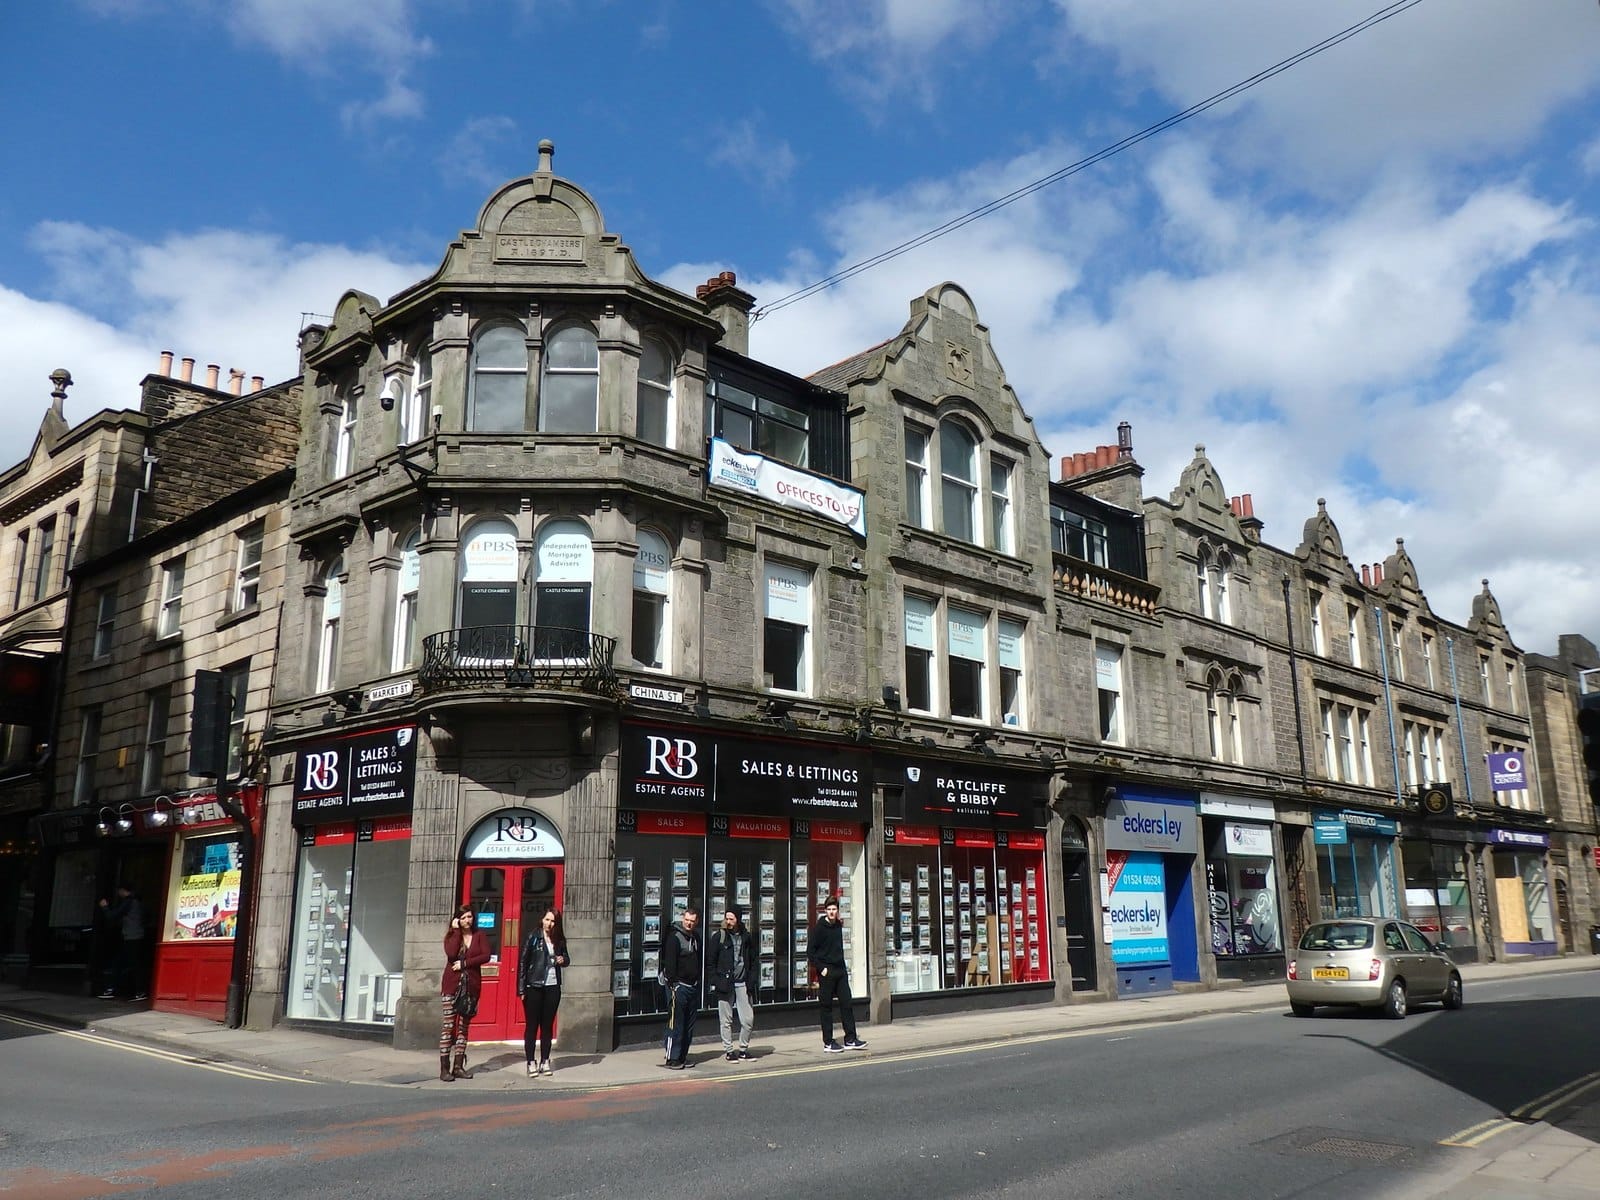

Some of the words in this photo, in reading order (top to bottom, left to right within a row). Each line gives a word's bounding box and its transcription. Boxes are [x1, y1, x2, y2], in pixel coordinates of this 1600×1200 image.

[500, 238, 537, 247] CASTLE
[537, 239, 581, 248] CHAMBERS
[776, 481, 824, 507] OFFICES
[825, 495, 841, 512] TO
[484, 541, 516, 552] PBS
[640, 550, 665, 566] PBS
[777, 577, 798, 590] PBS
[372, 686, 399, 699] MARKET
[400, 684, 408, 693] ST
[635, 687, 665, 699] CHINA
[667, 691, 678, 701] ST
[360, 746, 389, 762] SALES
[391, 745, 397, 757] &
[357, 761, 403, 778] LETTINGS
[742, 760, 782, 777] SALES
[786, 764, 795, 777] &
[799, 765, 858, 783] LETTINGS
[636, 783, 666, 795] ESTATE
[670, 786, 705, 797] AGENTS
[825, 788, 840, 796] 01524
[840, 789, 858, 797] 844111
[936, 778, 1007, 794] RATCLIFFE
[297, 799, 317, 810] ESTATE
[319, 796, 343, 807] AGENTS
[352, 789, 405, 803] www.rbestates.co.uk
[791, 797, 858, 808] www.rbestates.co.uk
[946, 792, 956, 803] &
[960, 793, 998, 806] BIBBY
[957, 807, 990, 815] solicitors
[657, 818, 684, 827] SALES
[735, 821, 782, 831] VALUATIONS
[1123, 808, 1182, 842] eckersley
[820, 826, 852, 836] LETTINGS
[1122, 874, 1142, 885] 01524
[1143, 874, 1161, 886] 60524
[180, 892, 209, 908] snacks
[1207, 864, 1221, 946] HAIRDRESSING
[179, 911, 191, 920] Beers
[1111, 900, 1161, 928] eckersley
